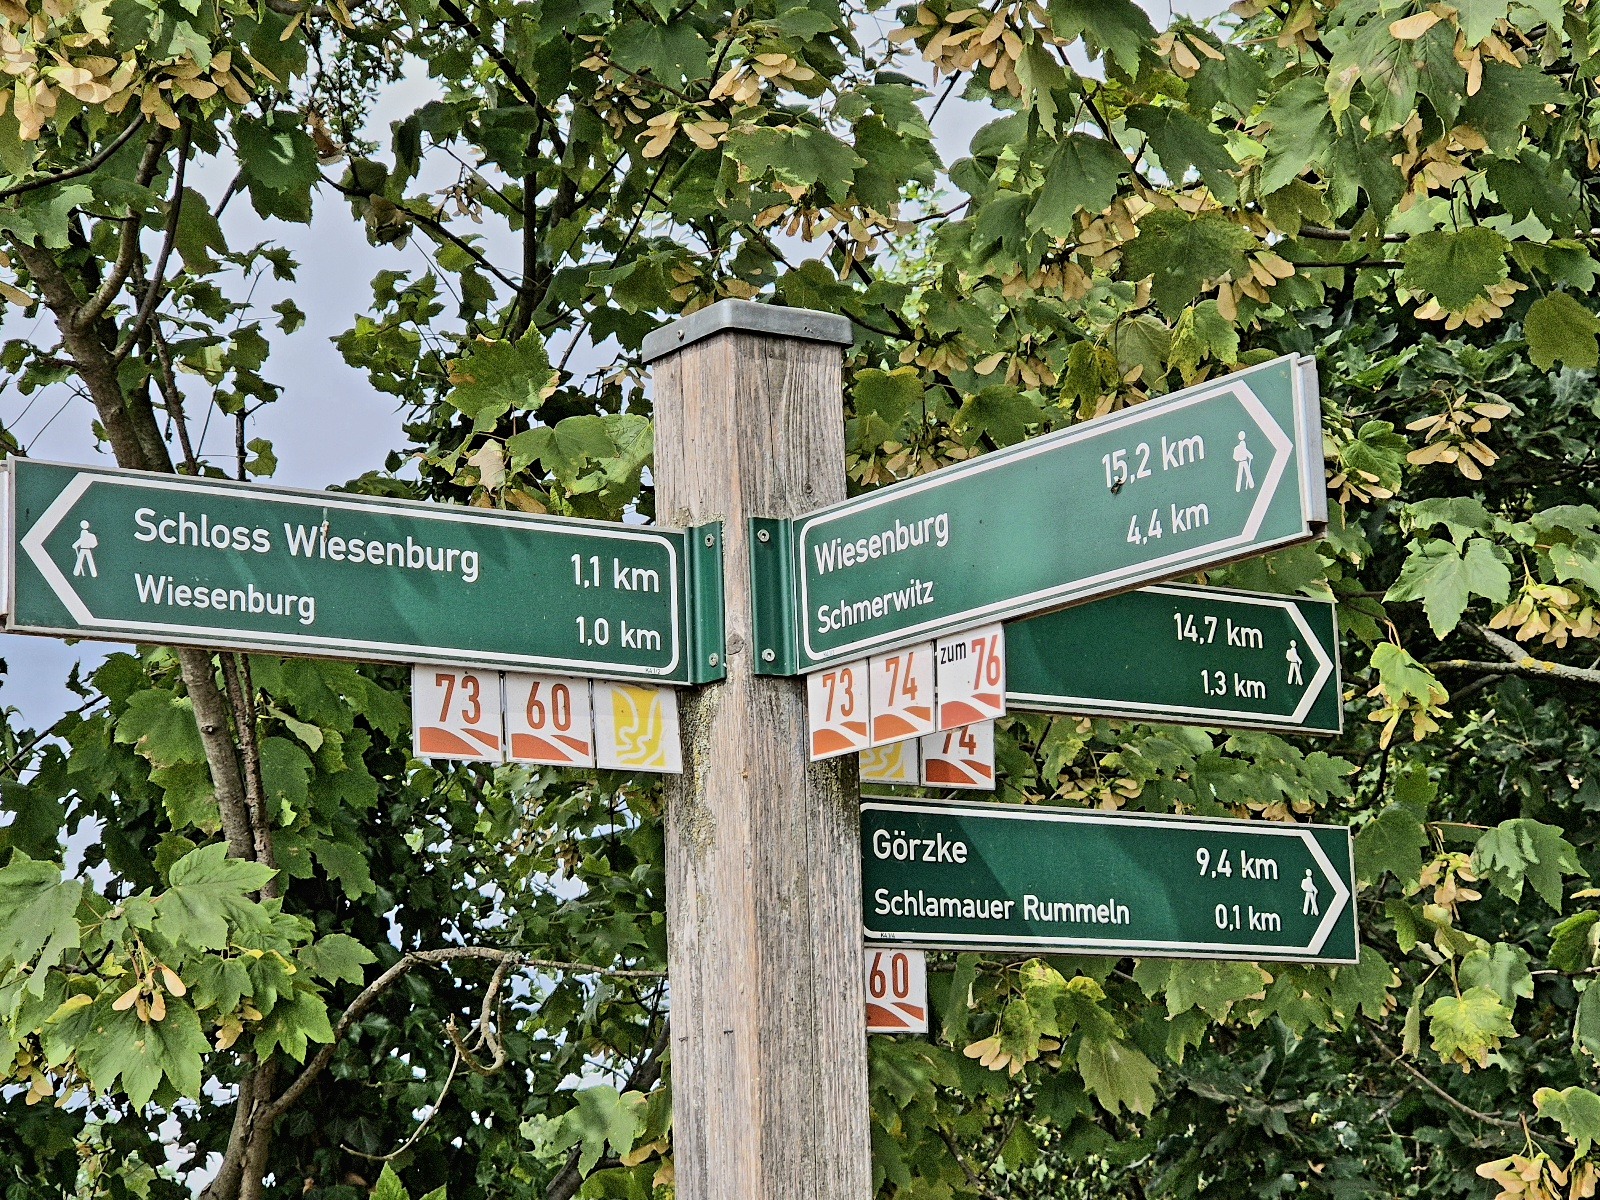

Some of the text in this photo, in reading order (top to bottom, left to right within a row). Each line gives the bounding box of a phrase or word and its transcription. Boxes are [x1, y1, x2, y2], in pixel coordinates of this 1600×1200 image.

[1102, 435, 1204, 487] 15,2 km
[134, 508, 479, 583] Schloss Wiesenburg
[814, 511, 949, 575] Wiesenburg
[1127, 504, 1208, 545] 4,4 km
[571, 554, 659, 592] 1,1 km
[134, 574, 315, 625] Wiesenburg
[818, 580, 935, 635] Schmerwitz
[576, 616, 660, 650] 1,0 km
[1174, 613, 1263, 648] 14,7 km
[885, 653, 917, 708] 74
[940, 635, 1001, 690] zum 76
[1201, 670, 1265, 699] 1,3 km
[435, 674, 481, 724] 73
[526, 682, 571, 731] 60
[822, 669, 854, 721] 73
[873, 829, 967, 863] Görzke
[1197, 848, 1278, 879] 9,4 km
[875, 889, 1129, 924] Schlamauer Rummeln
[1215, 904, 1280, 931] 0,1 km
[869, 953, 909, 998] 60
